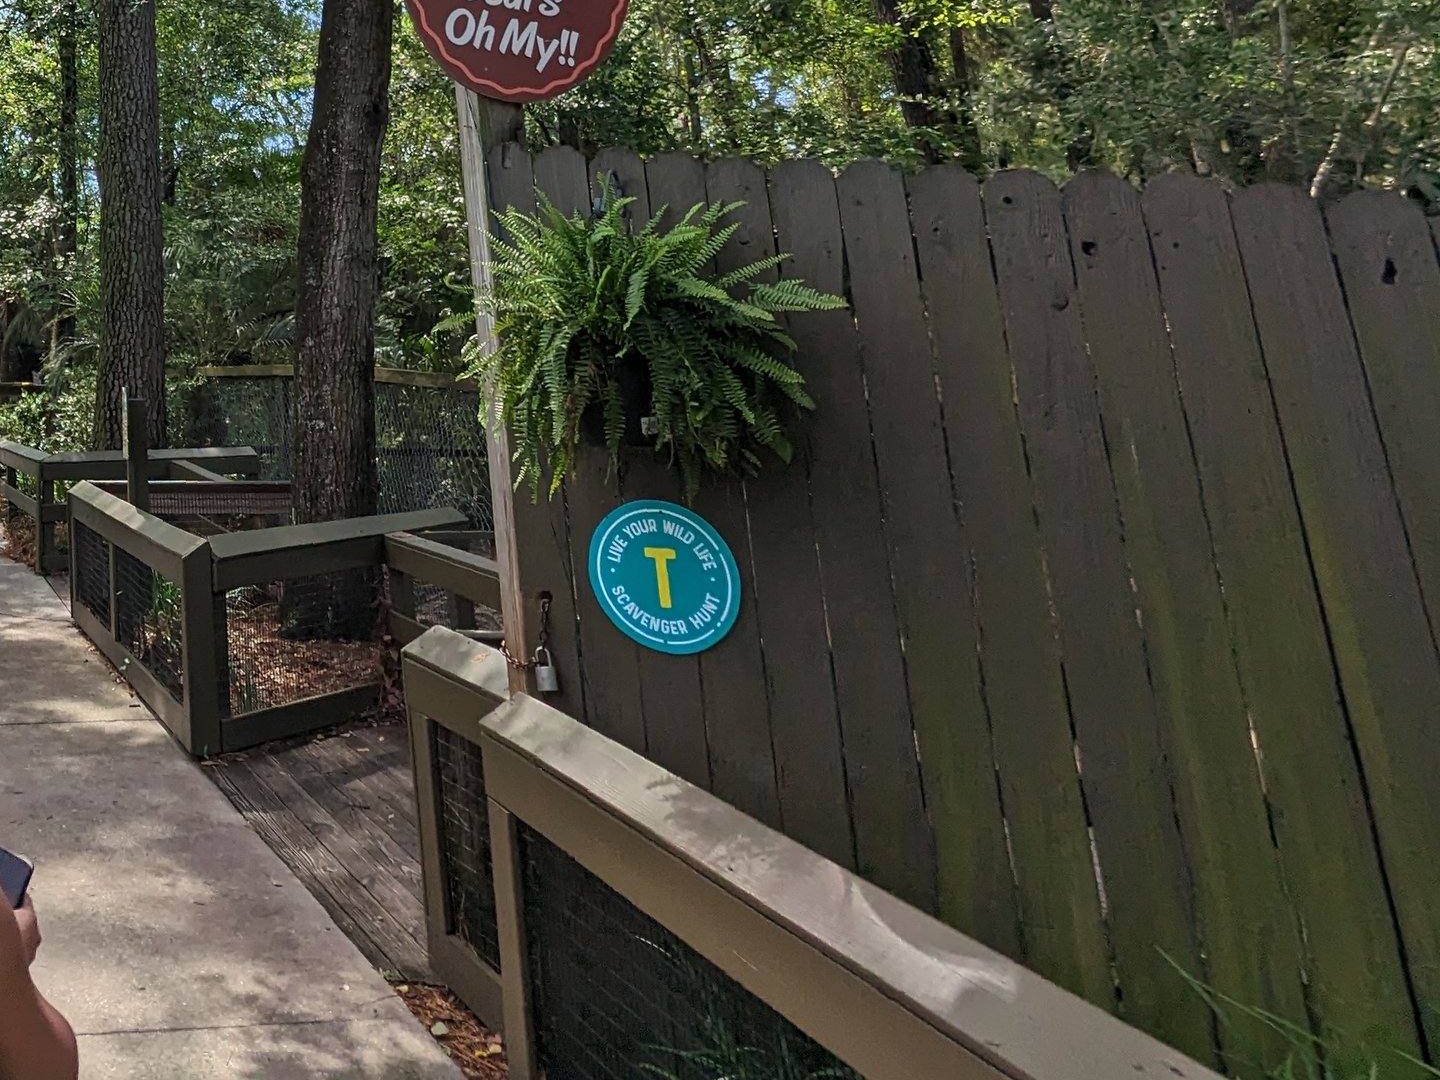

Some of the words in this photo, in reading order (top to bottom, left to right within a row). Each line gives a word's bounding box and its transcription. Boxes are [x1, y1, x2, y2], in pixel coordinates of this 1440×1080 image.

[445, 7, 495, 51] Oh
[500, 18, 580, 73] My!!
[607, 534, 628, 563] LIVE
[622, 519, 658, 540] YOUR
[662, 519, 695, 545] WILD
[693, 542, 717, 571] LIFE
[643, 547, 676, 608] T
[612, 585, 688, 635] SCAVENGER
[688, 592, 721, 630] HUNT
